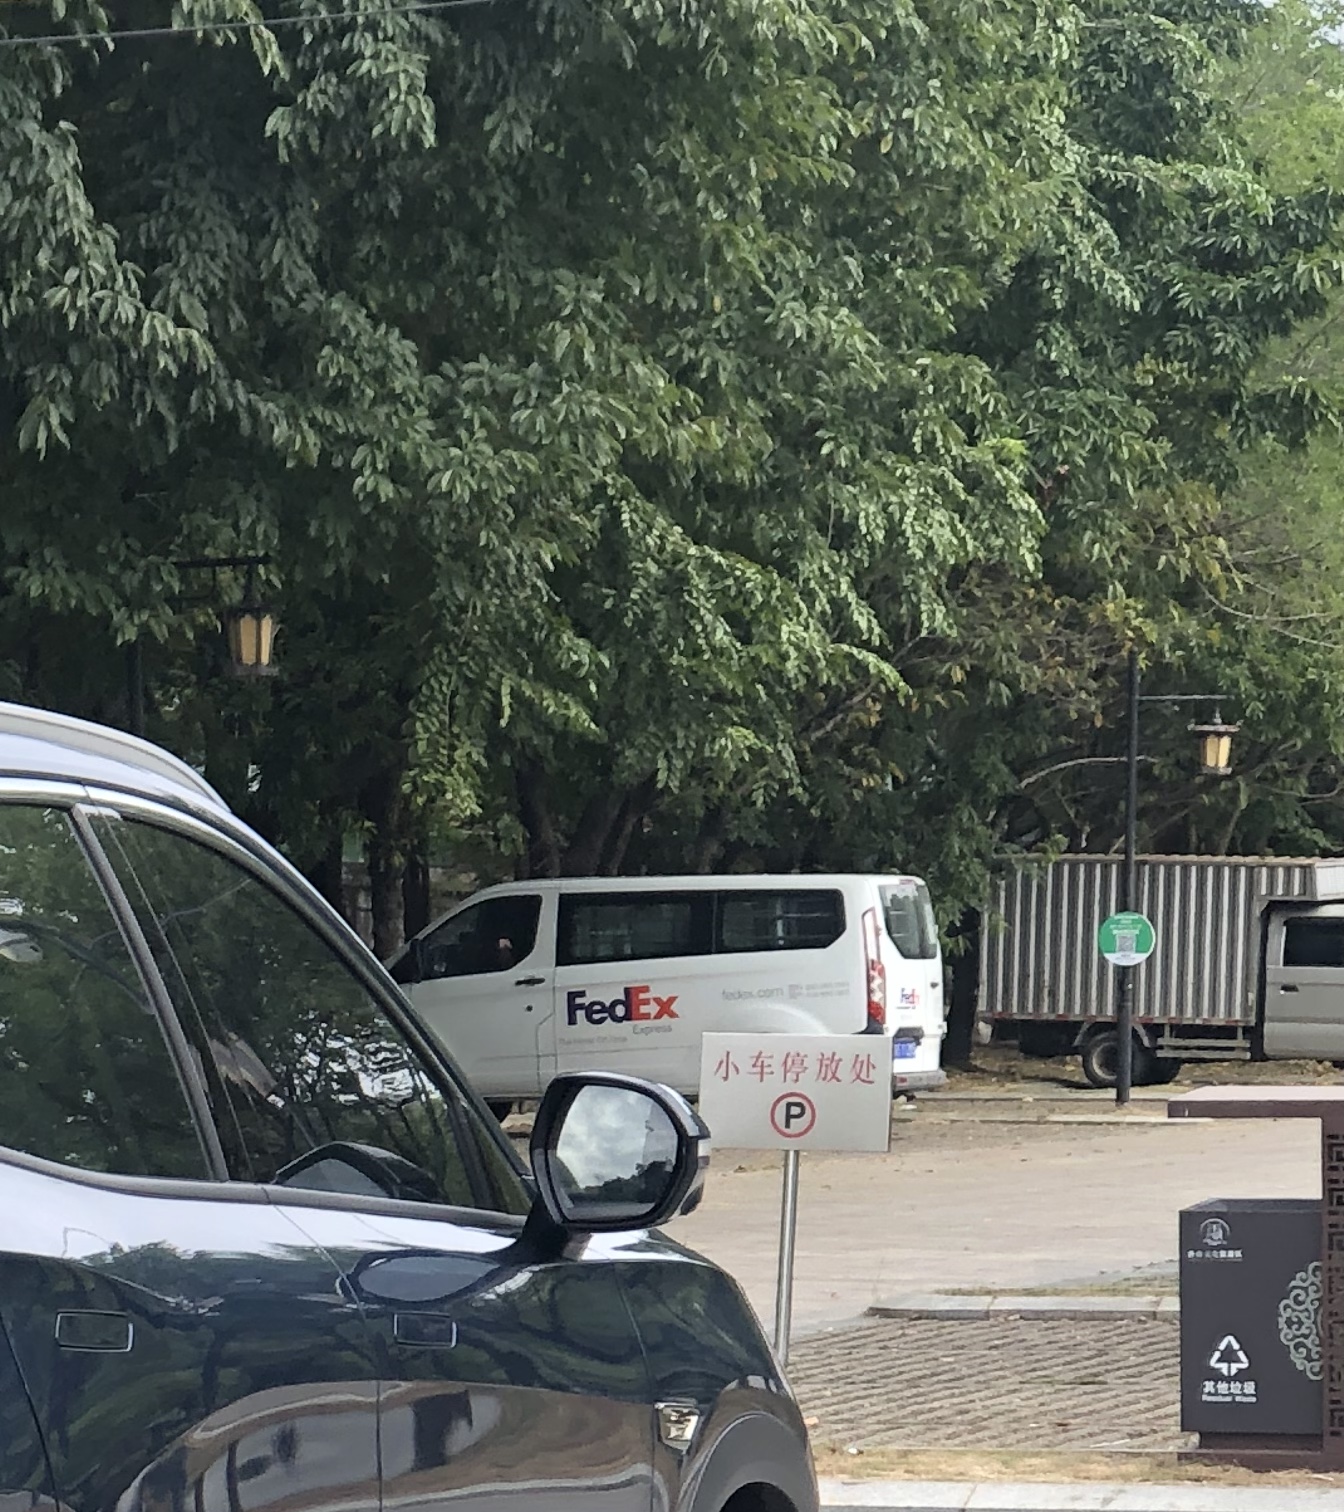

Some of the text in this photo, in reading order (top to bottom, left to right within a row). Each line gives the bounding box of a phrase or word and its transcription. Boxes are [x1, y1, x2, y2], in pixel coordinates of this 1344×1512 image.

[567, 985, 680, 1026] FedEx
[633, 1024, 672, 1036] Express
[714, 1050, 877, 1085] 小车停放处
[784, 1101, 806, 1129] P
[1202, 1380, 1256, 1395] 其他垃圾
